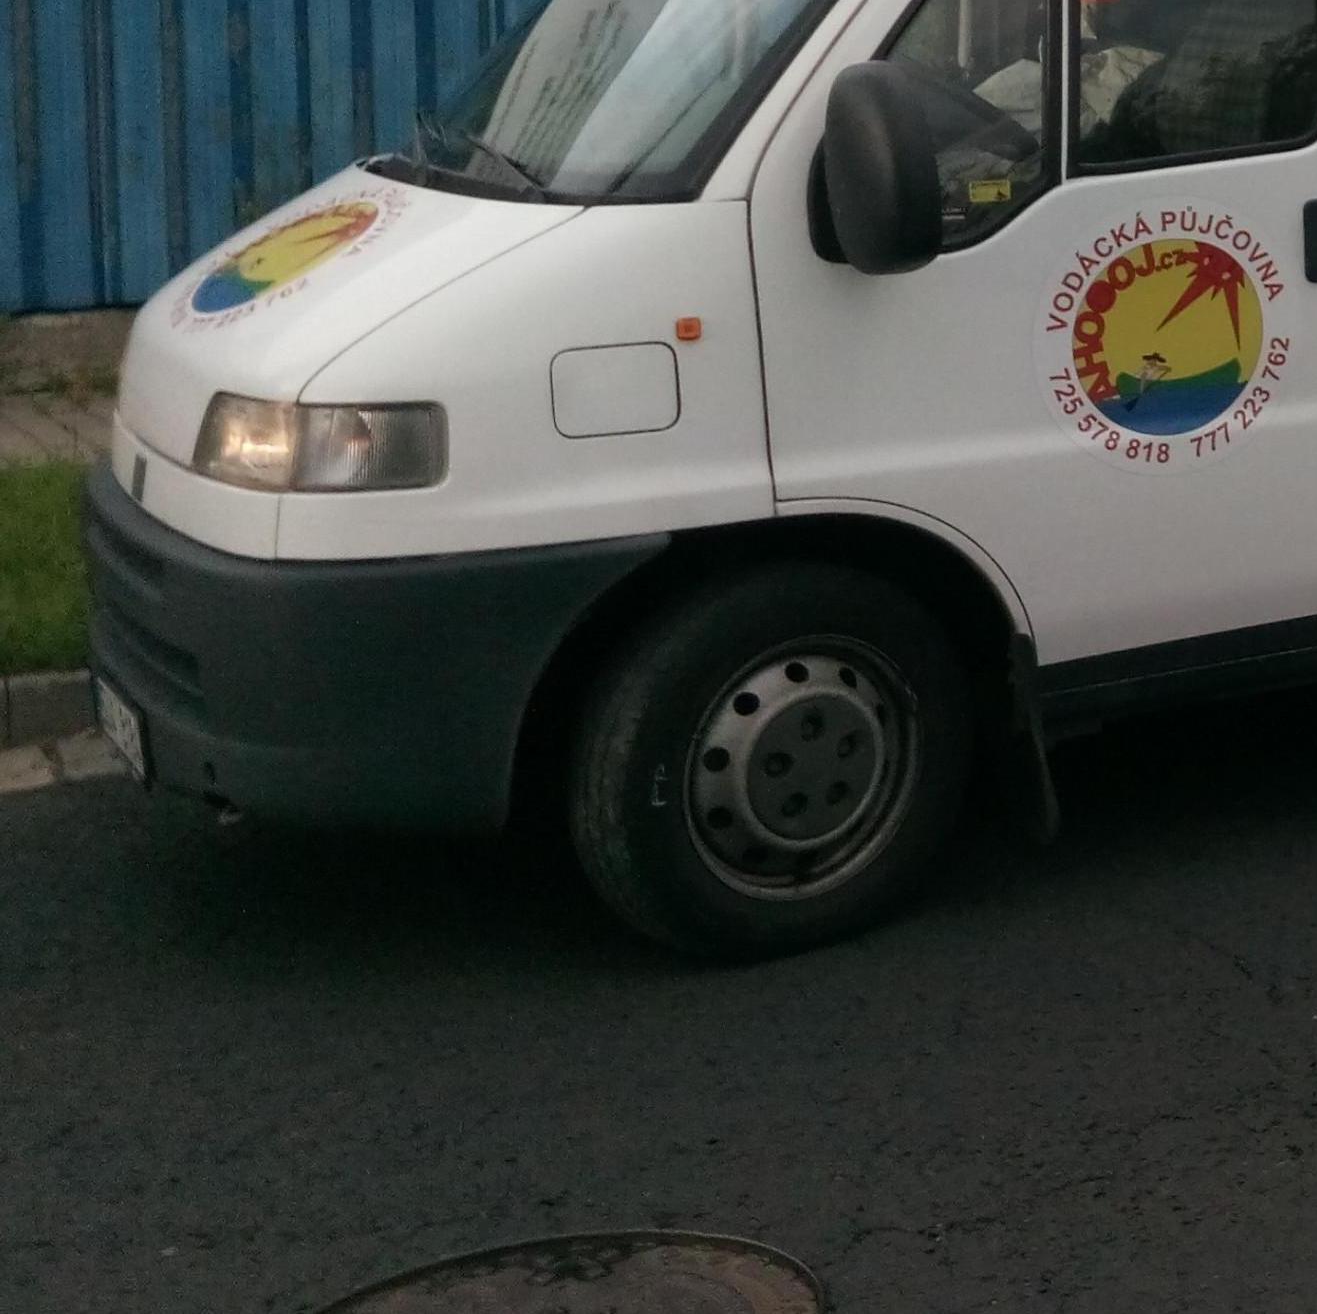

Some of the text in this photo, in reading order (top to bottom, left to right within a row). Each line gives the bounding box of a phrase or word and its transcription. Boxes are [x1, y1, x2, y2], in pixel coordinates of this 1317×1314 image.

[1046, 205, 1284, 332] VODÁCKÁ PŮJČOVNA
[1049, 337, 1290, 464] 725 578 818 777 223 762
